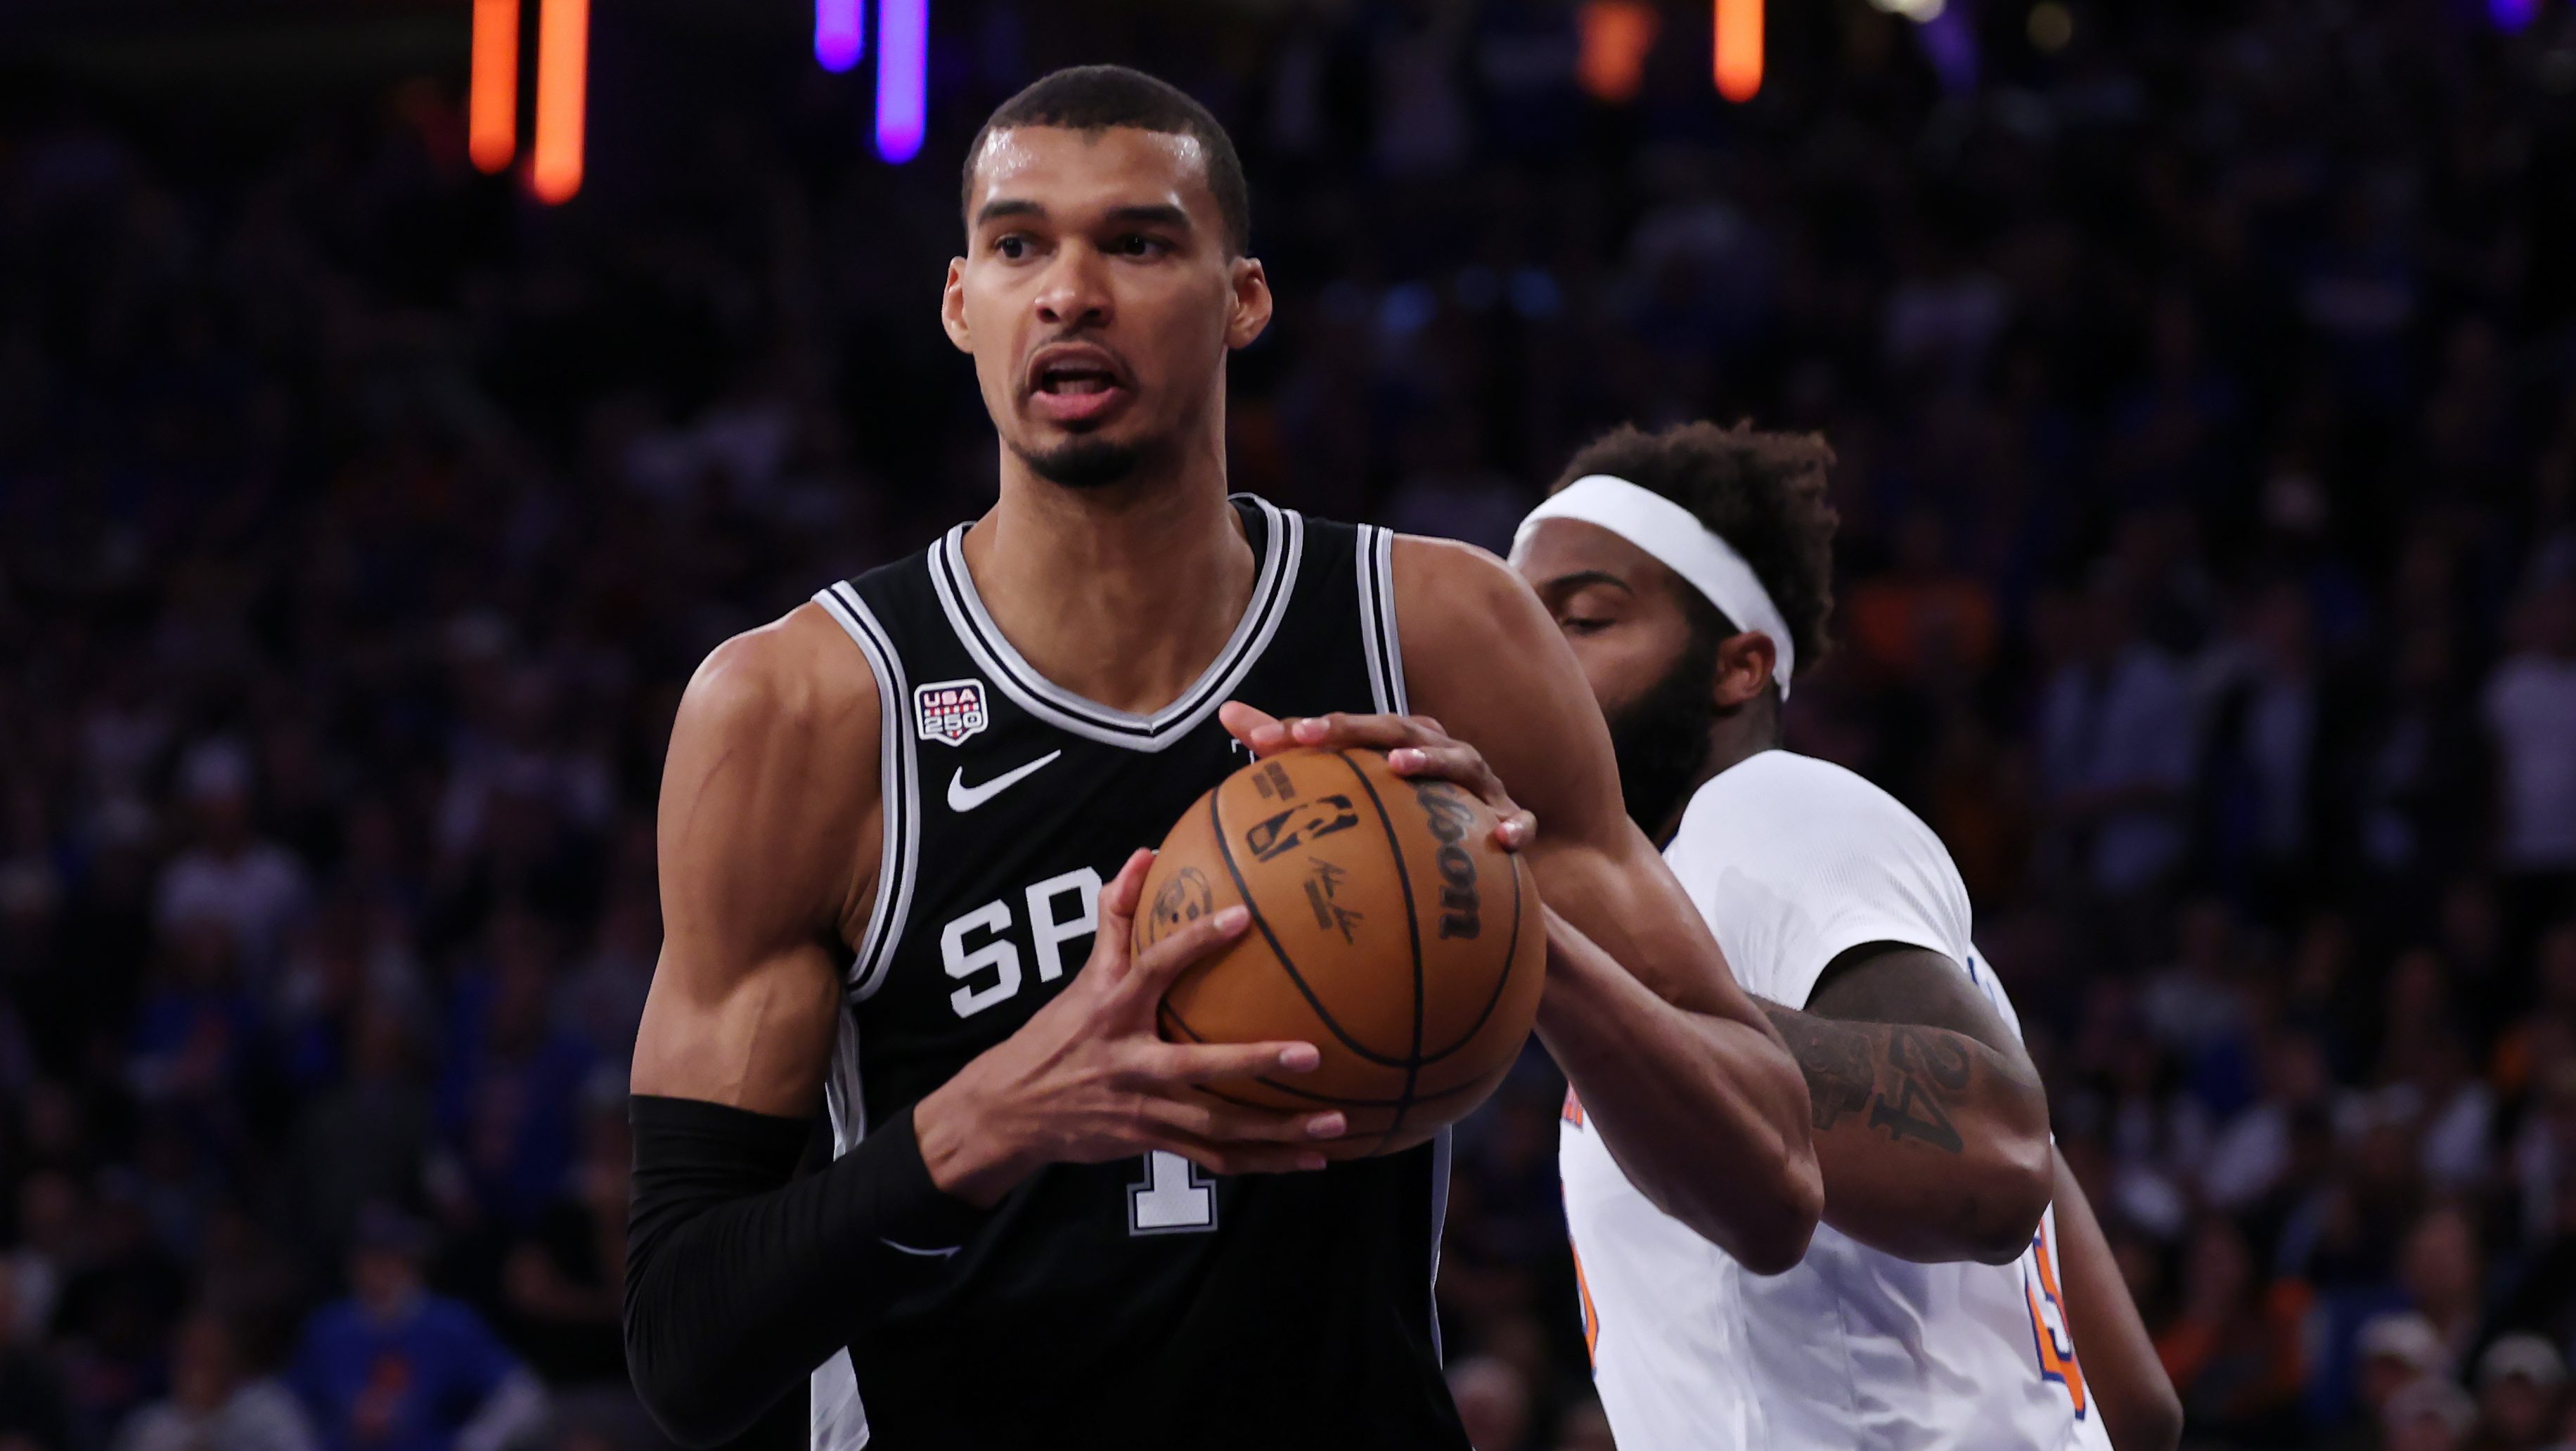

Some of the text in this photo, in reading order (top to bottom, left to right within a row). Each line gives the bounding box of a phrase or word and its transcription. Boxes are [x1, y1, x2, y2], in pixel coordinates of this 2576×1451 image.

[923, 688, 978, 708] USA
[924, 711, 982, 734] 250
[1417, 780, 1481, 940] lson
[941, 866, 1104, 1019] SP
[1868, 1024, 1970, 1154] 24
[1127, 1149, 1218, 1237] 1
